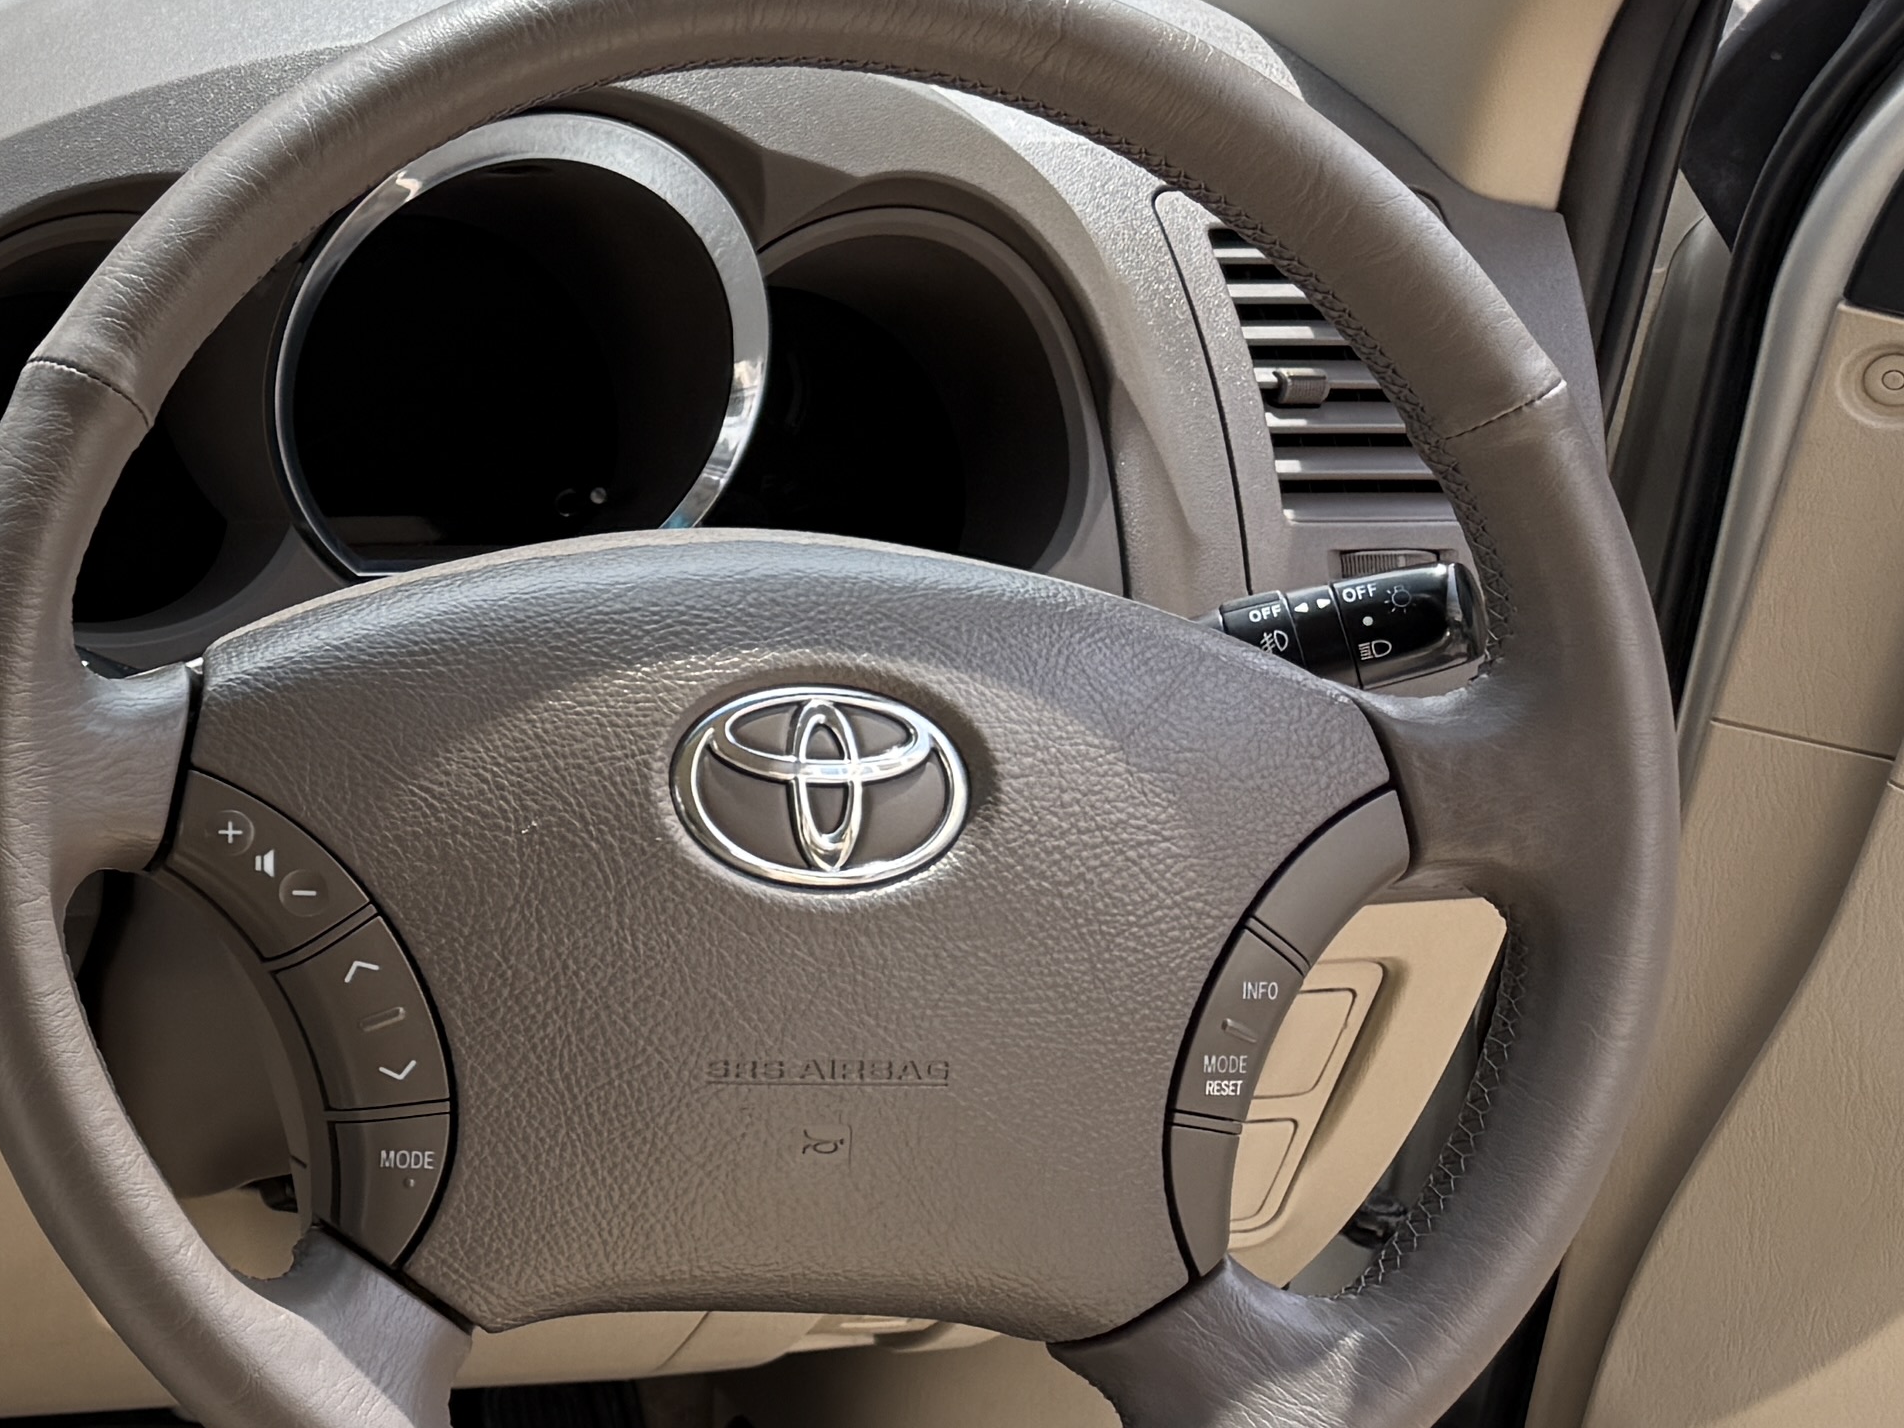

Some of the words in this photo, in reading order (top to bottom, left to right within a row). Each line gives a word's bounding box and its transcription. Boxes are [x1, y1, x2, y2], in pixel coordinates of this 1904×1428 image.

[1342, 582, 1378, 604] OFF
[1248, 603, 1282, 624] OFF
[1242, 981, 1278, 1000] INFO
[706, 1059, 786, 1081] SRS
[798, 1059, 951, 1082] AIRBAG
[1203, 1055, 1248, 1074] MODE
[1205, 1080, 1243, 1096] RESET
[381, 1150, 434, 1169] MODE
